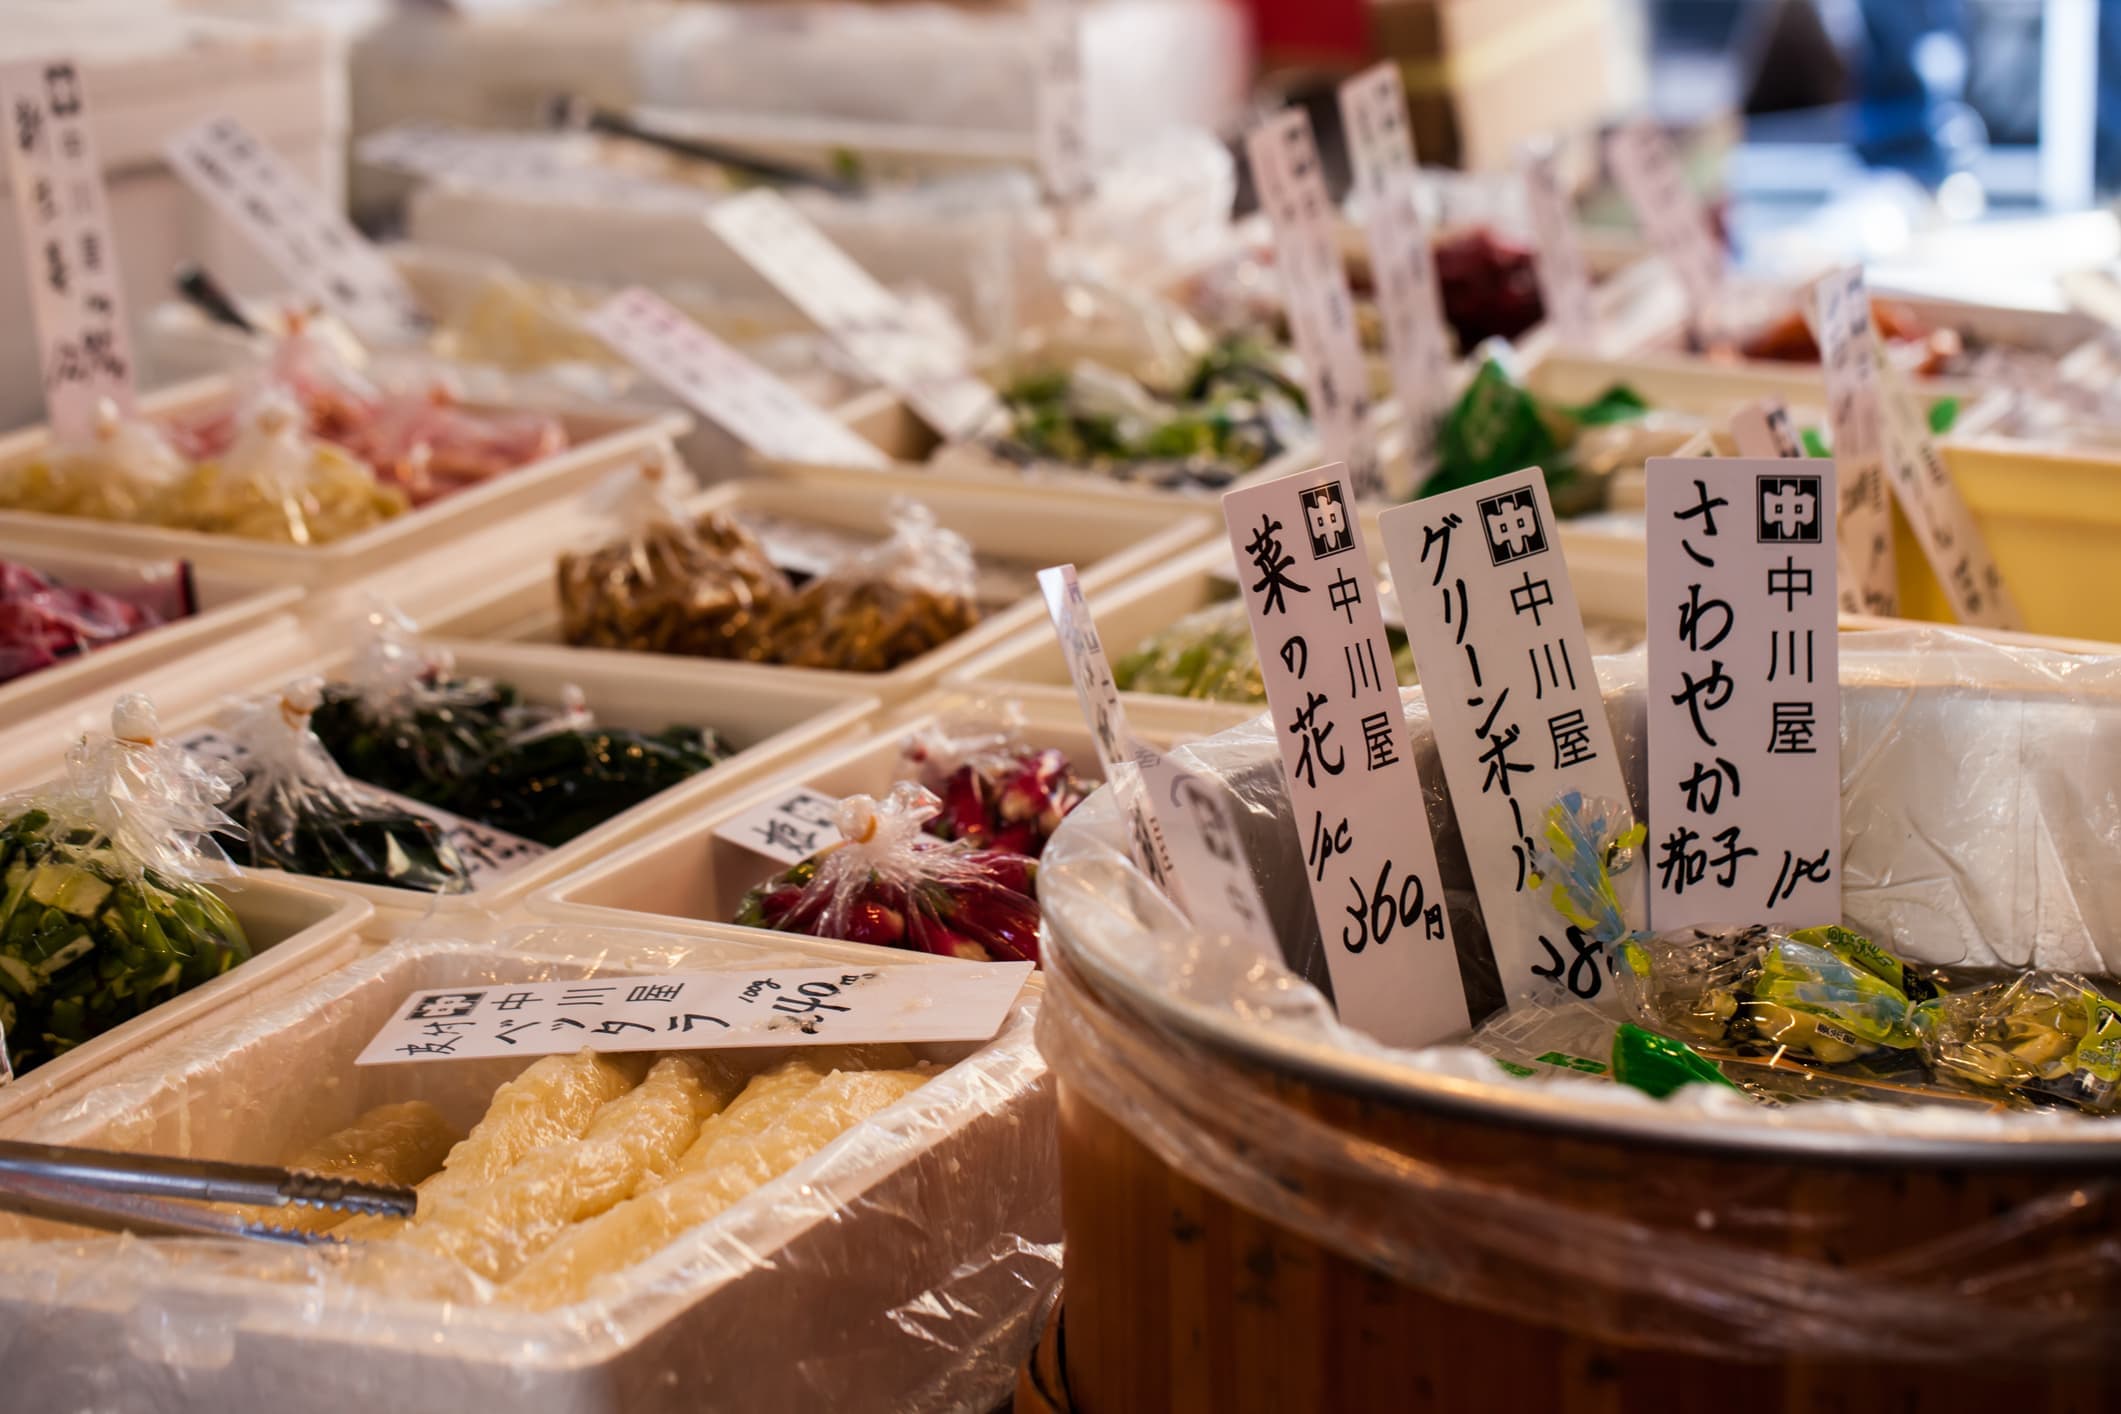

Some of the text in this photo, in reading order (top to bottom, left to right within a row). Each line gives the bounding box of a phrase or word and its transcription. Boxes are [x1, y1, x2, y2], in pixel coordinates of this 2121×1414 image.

[1245, 513, 1345, 788] 菜の花
[1327, 567, 1400, 771] 中川屋
[1509, 571, 1597, 770] 中川屋
[1767, 555, 1817, 754] 中川屋
[490, 982, 685, 1011] 中川屋
[1342, 859, 1445, 954] 360円
[495, 1013, 731, 1045] ベッタラ
